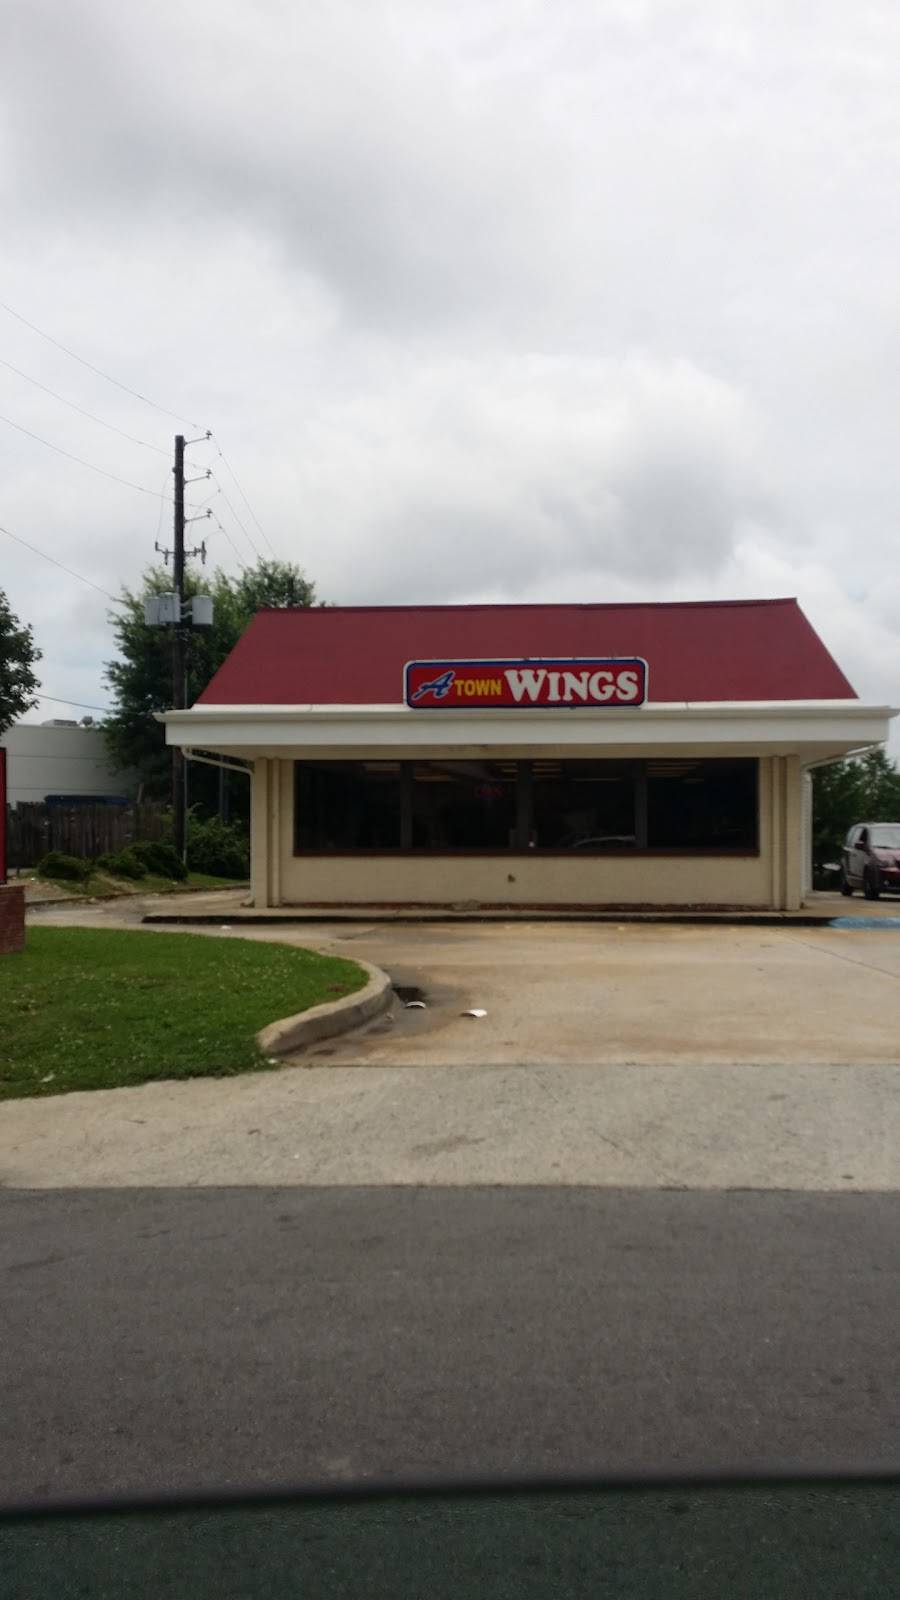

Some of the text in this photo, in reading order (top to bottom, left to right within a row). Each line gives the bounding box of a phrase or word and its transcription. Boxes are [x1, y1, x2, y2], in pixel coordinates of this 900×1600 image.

[412, 669, 638, 702] A TOWN WINGS
